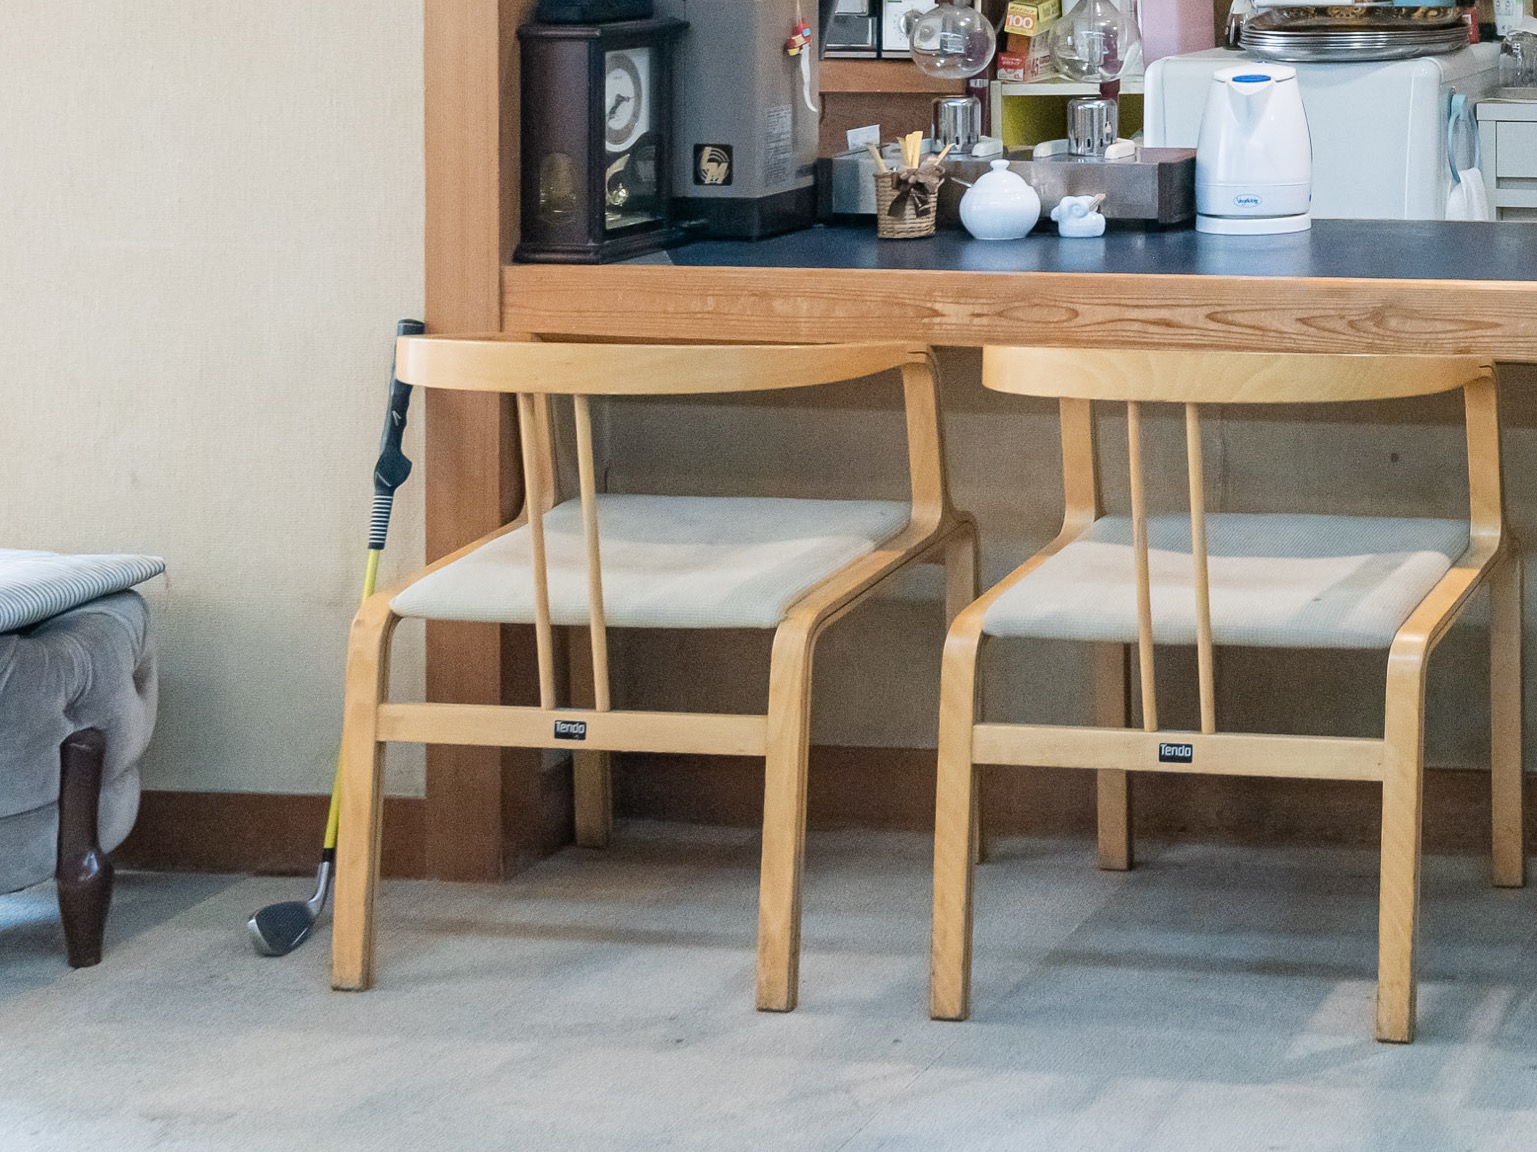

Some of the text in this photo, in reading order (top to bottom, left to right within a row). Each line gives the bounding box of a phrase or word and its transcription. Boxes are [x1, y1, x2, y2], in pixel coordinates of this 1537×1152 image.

[1008, 15, 1033, 29] 100
[556, 721, 585, 734] Tendo
[1160, 744, 1191, 757] Tendo
